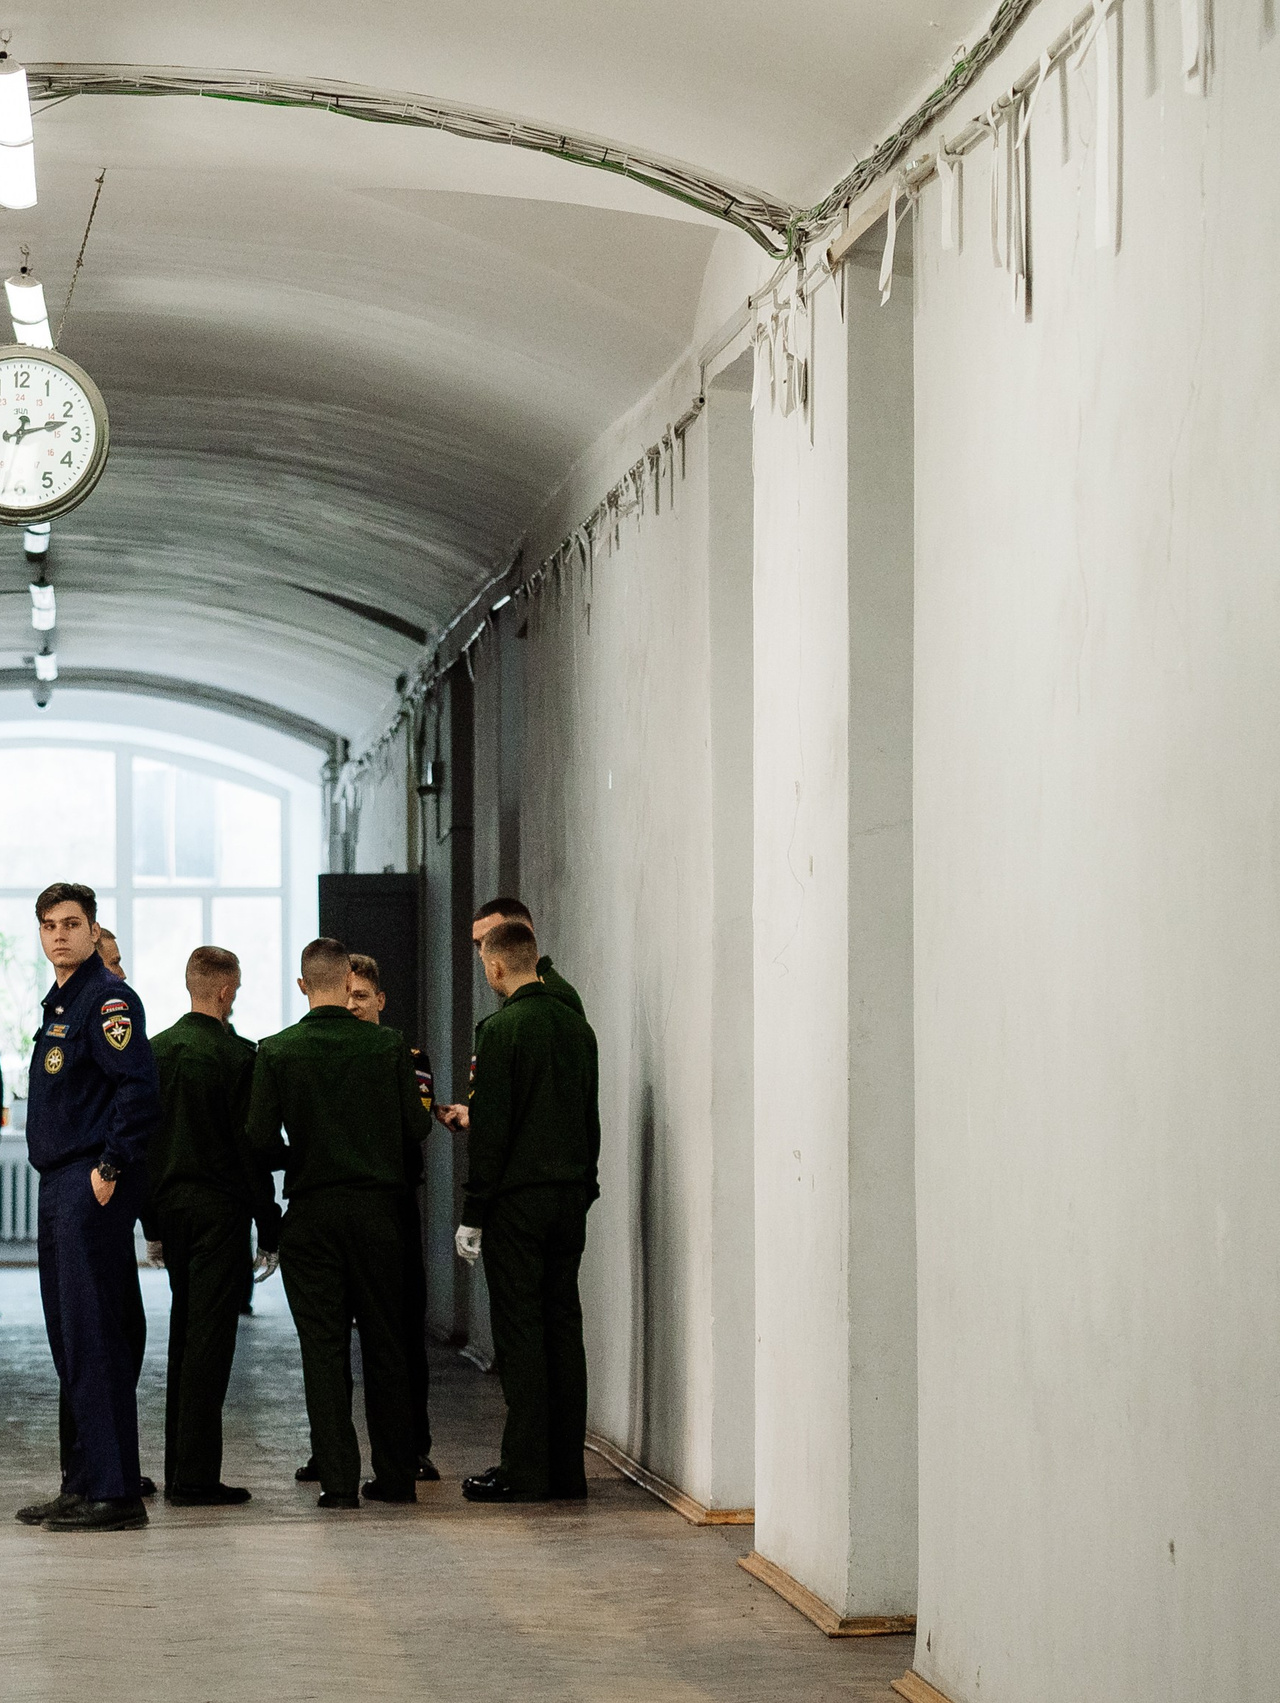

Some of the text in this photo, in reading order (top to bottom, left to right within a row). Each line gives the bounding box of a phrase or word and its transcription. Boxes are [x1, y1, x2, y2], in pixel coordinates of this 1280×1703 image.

[13, 371, 31, 388] 12
[45, 380, 50, 397] 1
[15, 394, 26, 402] 24
[36, 399, 43, 407] 13
[63, 401, 73, 418] 2
[71, 426, 82, 443] 3
[47, 449, 55, 457] 16
[60, 451, 73, 468] 4
[42, 471, 53, 489] 5
